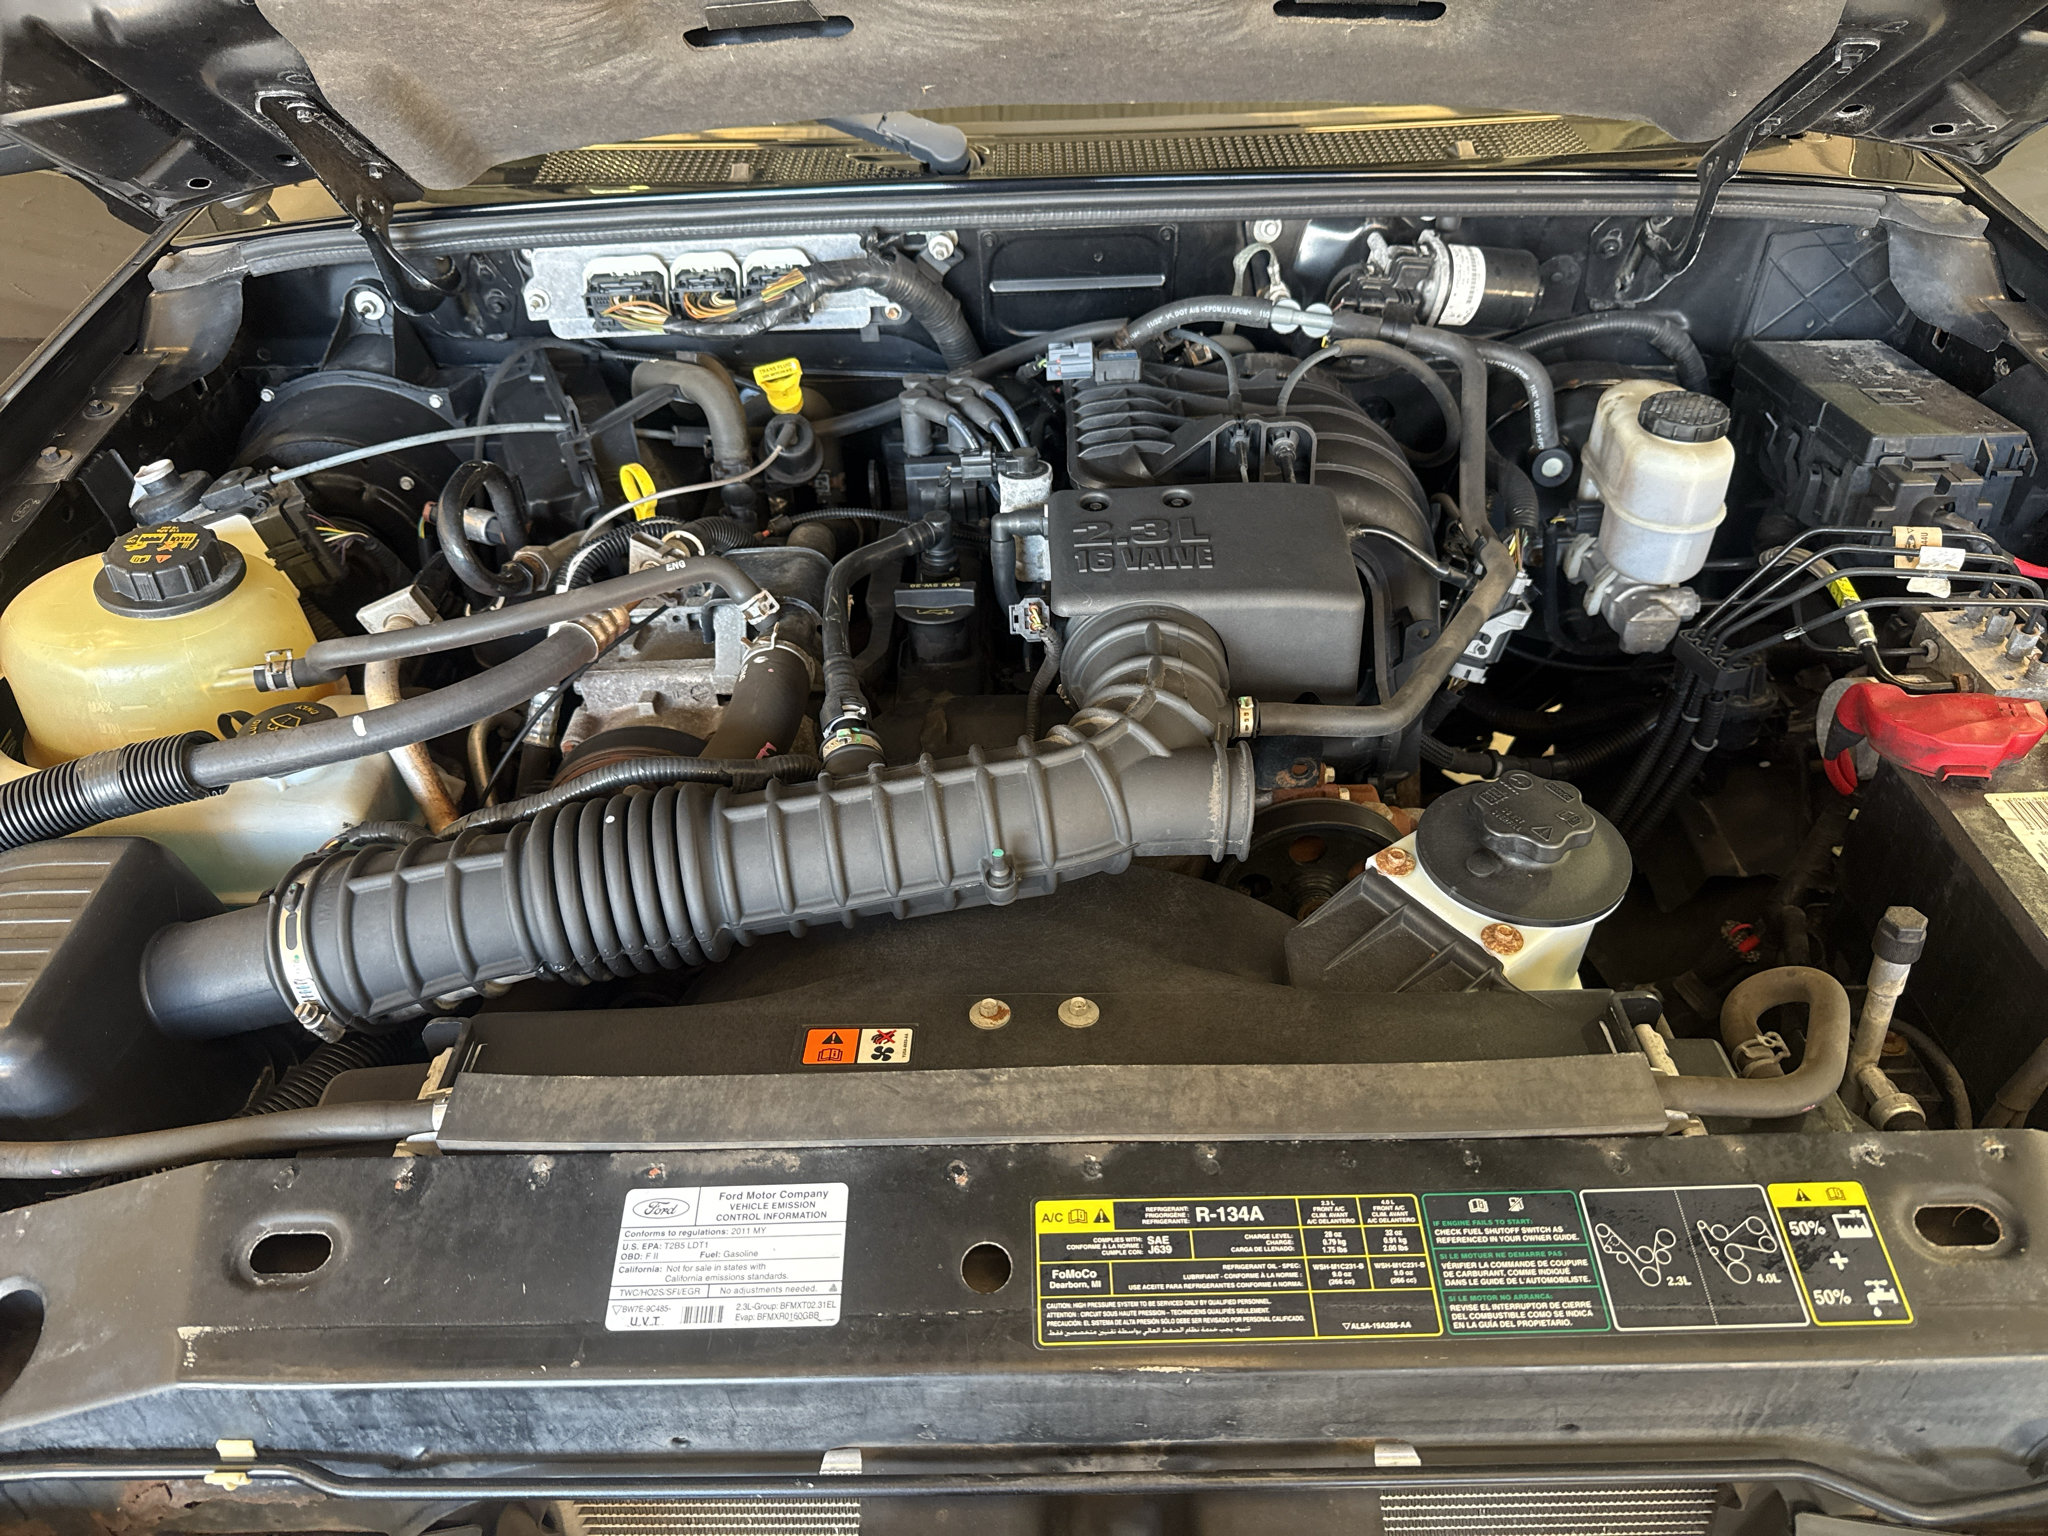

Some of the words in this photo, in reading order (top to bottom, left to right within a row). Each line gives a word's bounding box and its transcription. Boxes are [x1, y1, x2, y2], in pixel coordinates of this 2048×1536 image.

[1073, 517, 1210, 548] 2.3L
[1074, 549, 1114, 573] 16
[1120, 545, 1213, 571] VALVE
[665, 560, 687, 572] ENG
[718, 1191, 743, 1200] Ford
[746, 1191, 776, 1199] Motor
[779, 1190, 829, 1199] Company
[643, 1201, 677, 1216] Ford
[729, 1202, 768, 1210] VEHICLE
[771, 1201, 816, 1209] EMISSION
[715, 1213, 760, 1221] CONTROL
[763, 1211, 827, 1220] INFORMATION
[1041, 1213, 1063, 1223] A/C
[1194, 1206, 1265, 1222] R-134A
[624, 1229, 665, 1237] Conforms
[678, 1228, 728, 1236] regulations:
[731, 1227, 749, 1235] 2011
[1788, 1221, 1827, 1236] 50%
[1147, 1236, 1169, 1245] SAE
[641, 1242, 661, 1250] EPA:
[1148, 1245, 1173, 1254] J639
[723, 1250, 759, 1258] Gasoline
[618, 1265, 662, 1273] California:
[695, 1264, 711, 1272] sale
[724, 1263, 746, 1271] states
[750, 1263, 766, 1271] with
[1441, 1261, 1477, 1269] VÉRIFIER
[1490, 1260, 1535, 1268] COMMANDE
[1549, 1259, 1589, 1267] COUPURE
[665, 1274, 702, 1282] California
[705, 1273, 744, 1281] emissions
[747, 1272, 789, 1281] standards.
[1051, 1269, 1098, 1279] FoMoCo
[1756, 1273, 1782, 1283] 4.0L
[1518, 1276, 1591, 1284] L'AUTOMOBILISTE.
[1667, 1276, 1692, 1286] 2.3L
[719, 1287, 731, 1295] No
[733, 1286, 782, 1294] adjustments
[785, 1285, 818, 1293] needed.
[1813, 1290, 1852, 1305] 50%
[1491, 1302, 1547, 1310] INTERRUPTOR
[1561, 1301, 1592, 1309] CIERRE
[1499, 1320, 1515, 1328] DEL
